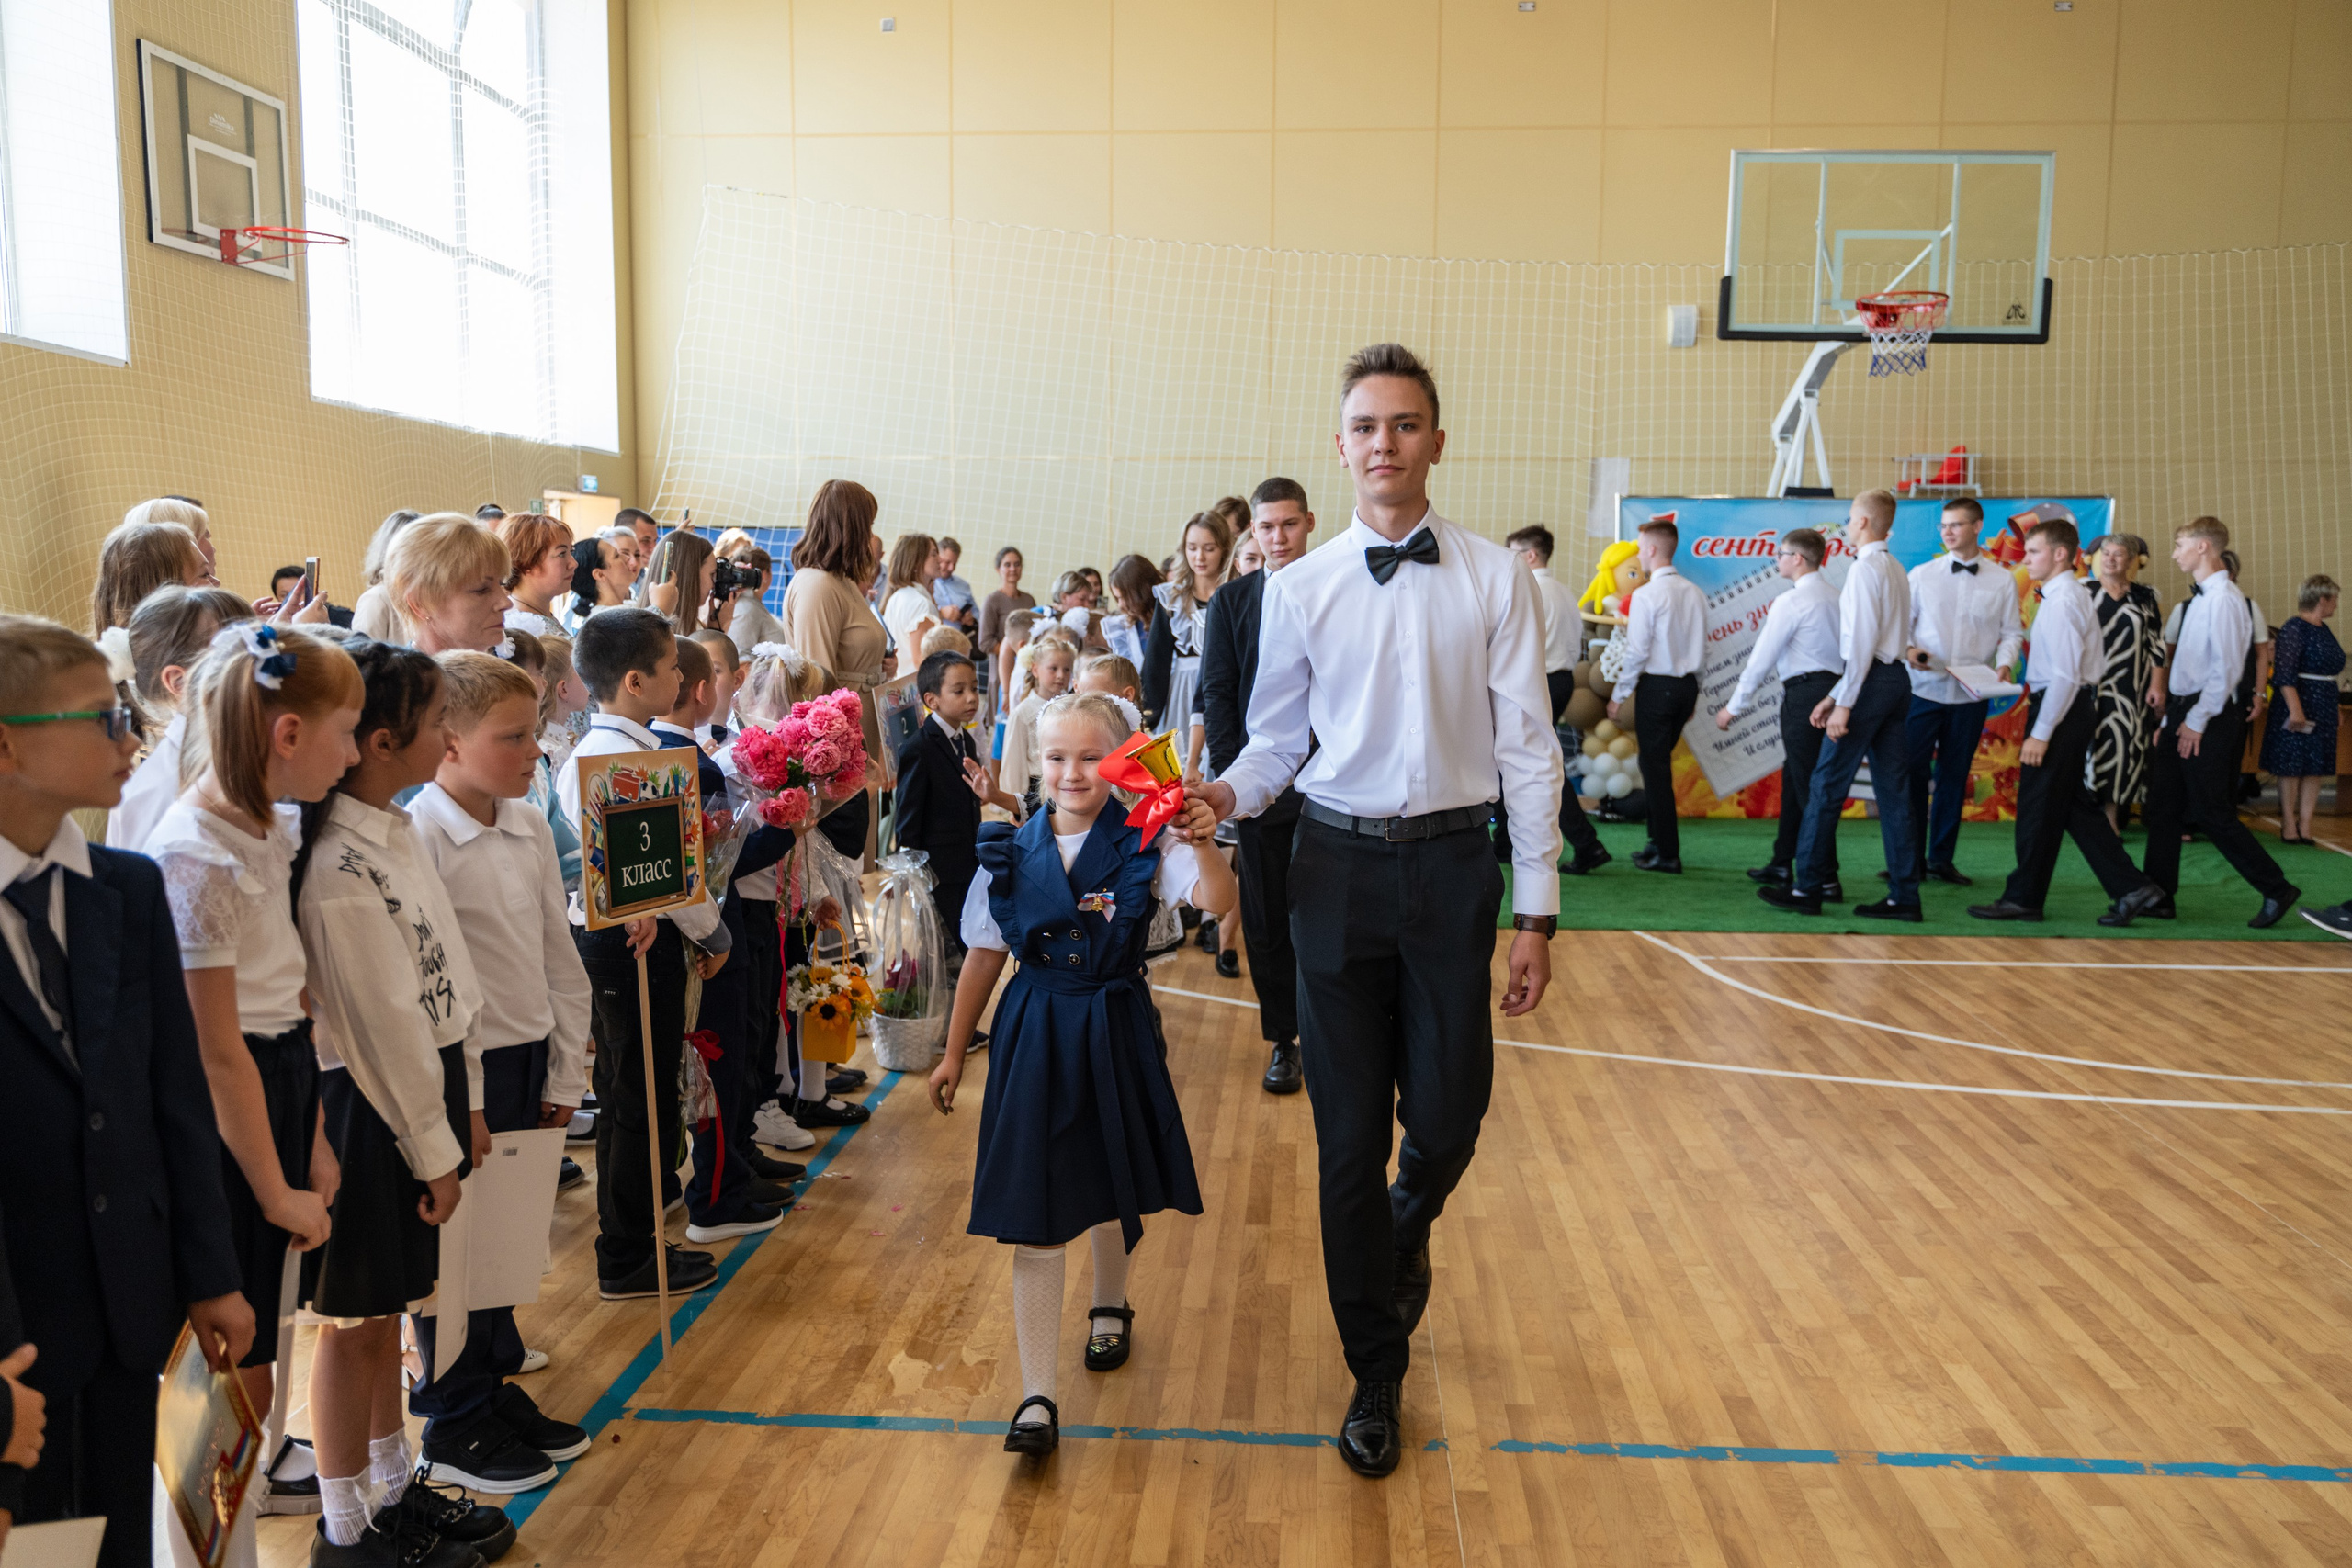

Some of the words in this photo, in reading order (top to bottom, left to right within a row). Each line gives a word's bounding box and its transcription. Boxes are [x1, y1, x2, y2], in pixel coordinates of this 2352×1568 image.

[1707, 619, 1743, 642] ень
[901, 716, 909, 735] 2
[1750, 713, 1781, 732] стар
[639, 821, 650, 852] 3
[621, 857, 672, 888] класс
